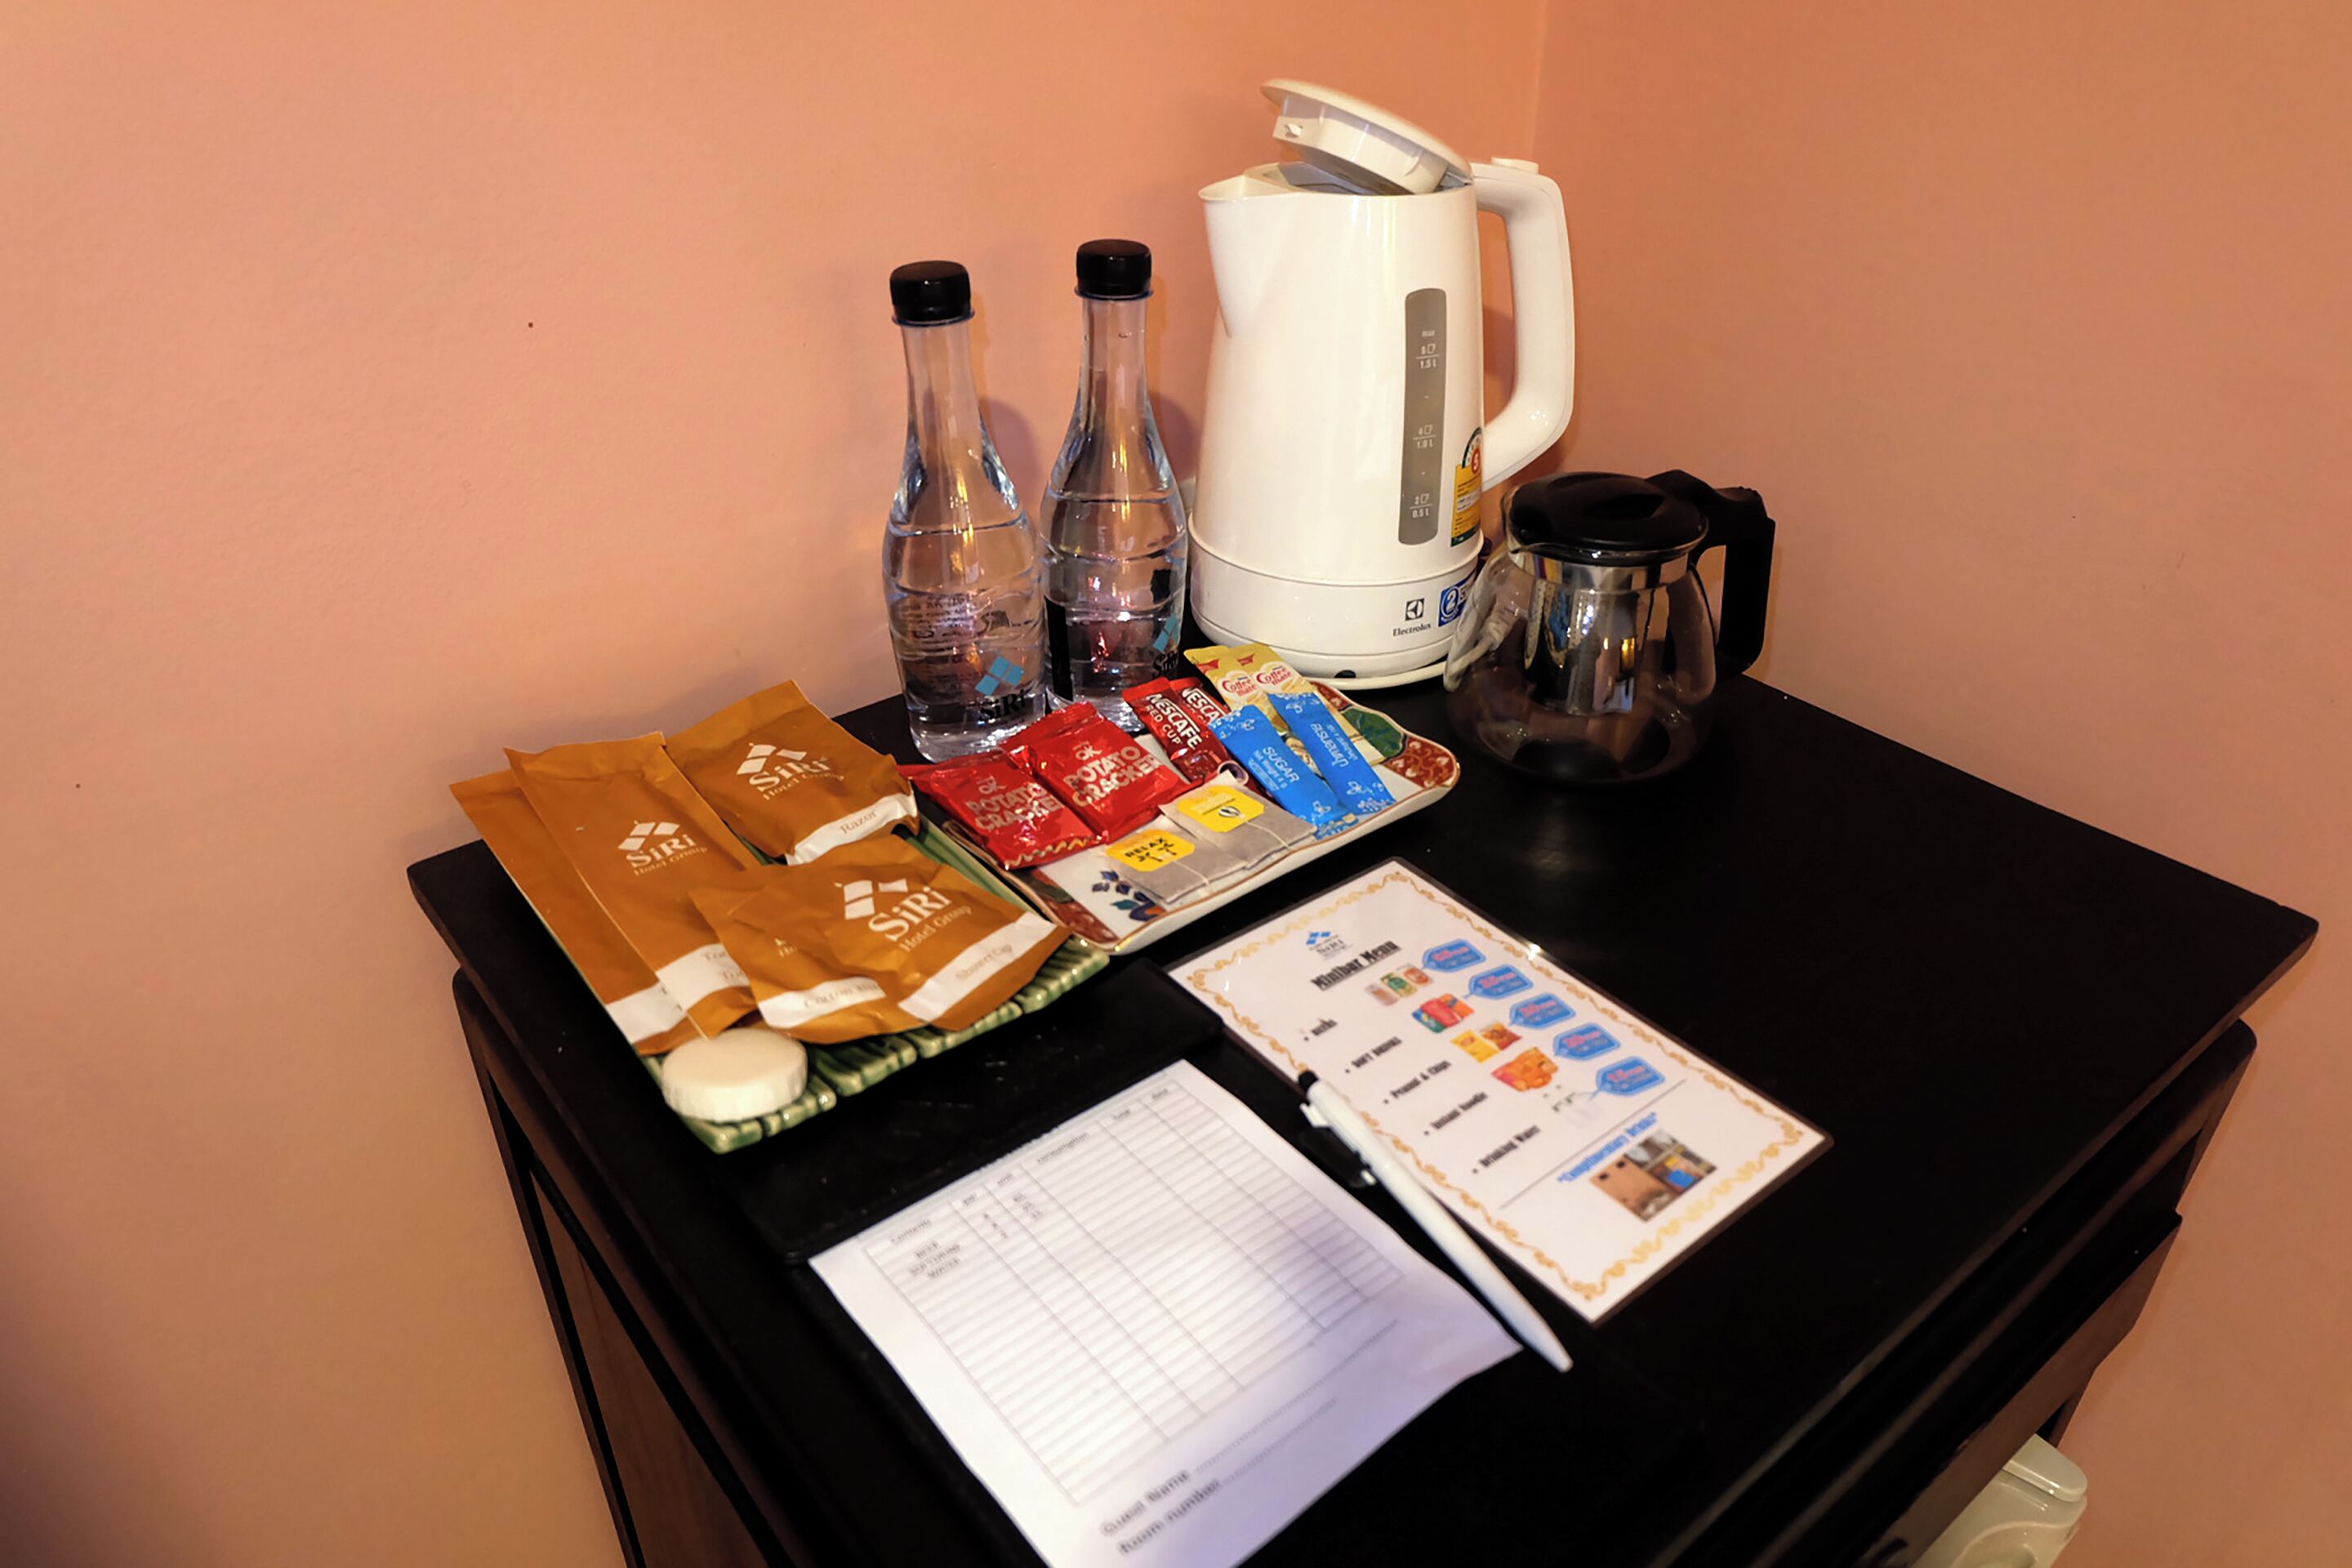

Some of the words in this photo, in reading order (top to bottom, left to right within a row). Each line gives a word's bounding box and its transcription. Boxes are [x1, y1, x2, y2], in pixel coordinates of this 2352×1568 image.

[1392, 623, 1432, 636] Electrolux
[1222, 678, 1252, 693] Coffee
[1256, 666, 1287, 684] Coffee
[1272, 670, 1292, 686] mate
[1145, 705, 1163, 723] RED
[1162, 724, 1182, 744] CUP
[1063, 746, 1141, 787] POTATO
[1076, 744, 1102, 761] OK
[1263, 746, 1300, 783] SUGAR
[1072, 754, 1162, 807] CRACKER
[965, 782, 1048, 815] POTATO
[839, 808, 877, 835] Razor
[626, 834, 697, 869] SiRi
[1125, 838, 1168, 858] RELAX
[633, 860, 668, 876] Hotel
[868, 886, 951, 942] SiRi
[899, 923, 937, 951] Hotel
[933, 906, 973, 934] Group
[1311, 958, 1365, 989] Minibar
[1361, 940, 1401, 964] Menu
